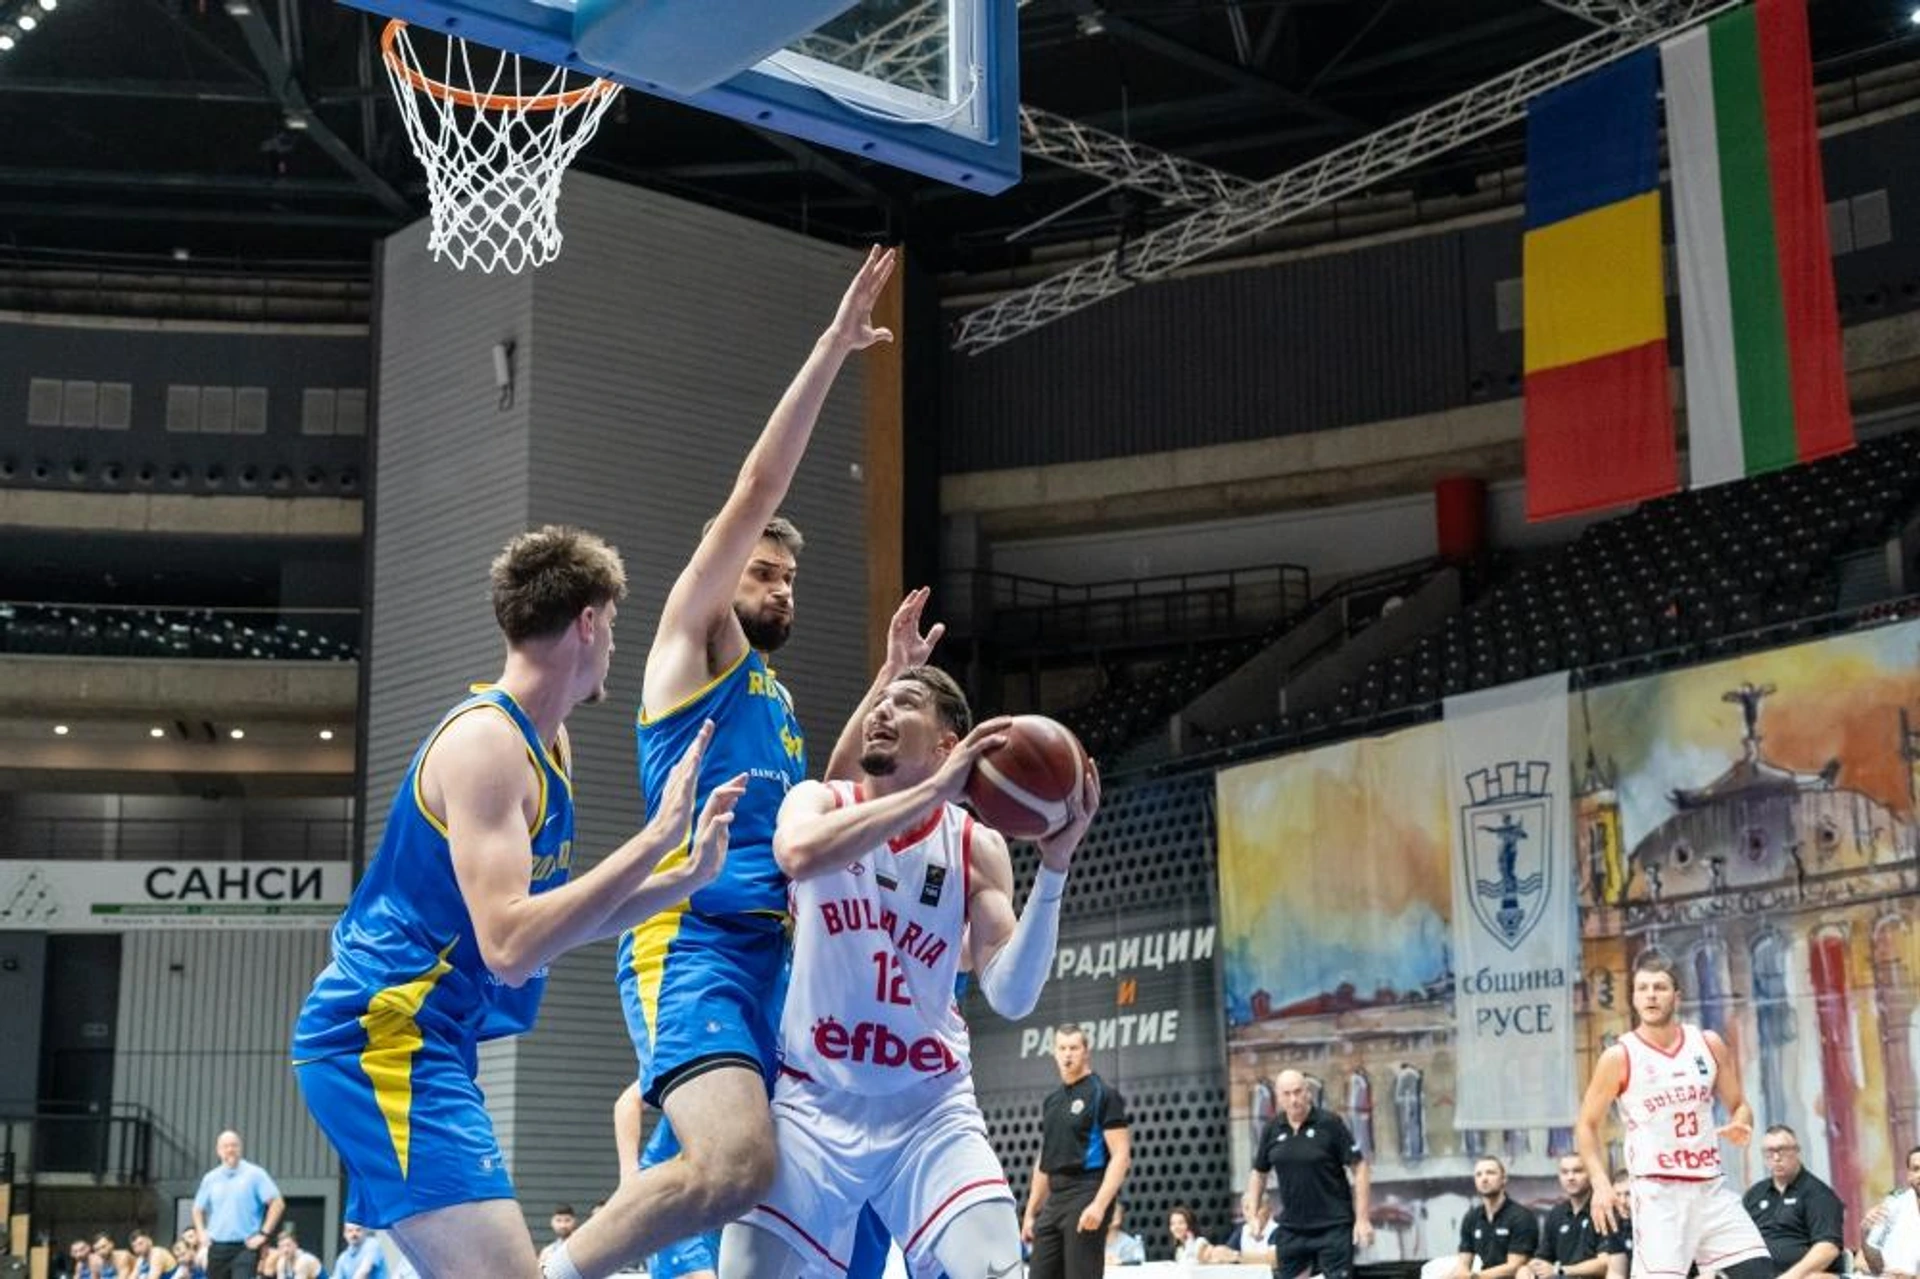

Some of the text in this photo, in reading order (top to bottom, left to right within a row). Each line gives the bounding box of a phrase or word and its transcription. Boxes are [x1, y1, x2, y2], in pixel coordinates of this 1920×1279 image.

[145, 866, 323, 900] САНСИ
[1054, 926, 1216, 979] РАДИЦИИ
[873, 950, 912, 1006] 12
[1462, 965, 1565, 995] община
[1020, 1010, 1179, 1058] РАВИТИЕ
[1476, 1003, 1554, 1037] РУСЕ
[1674, 1110, 1699, 1138] 23
